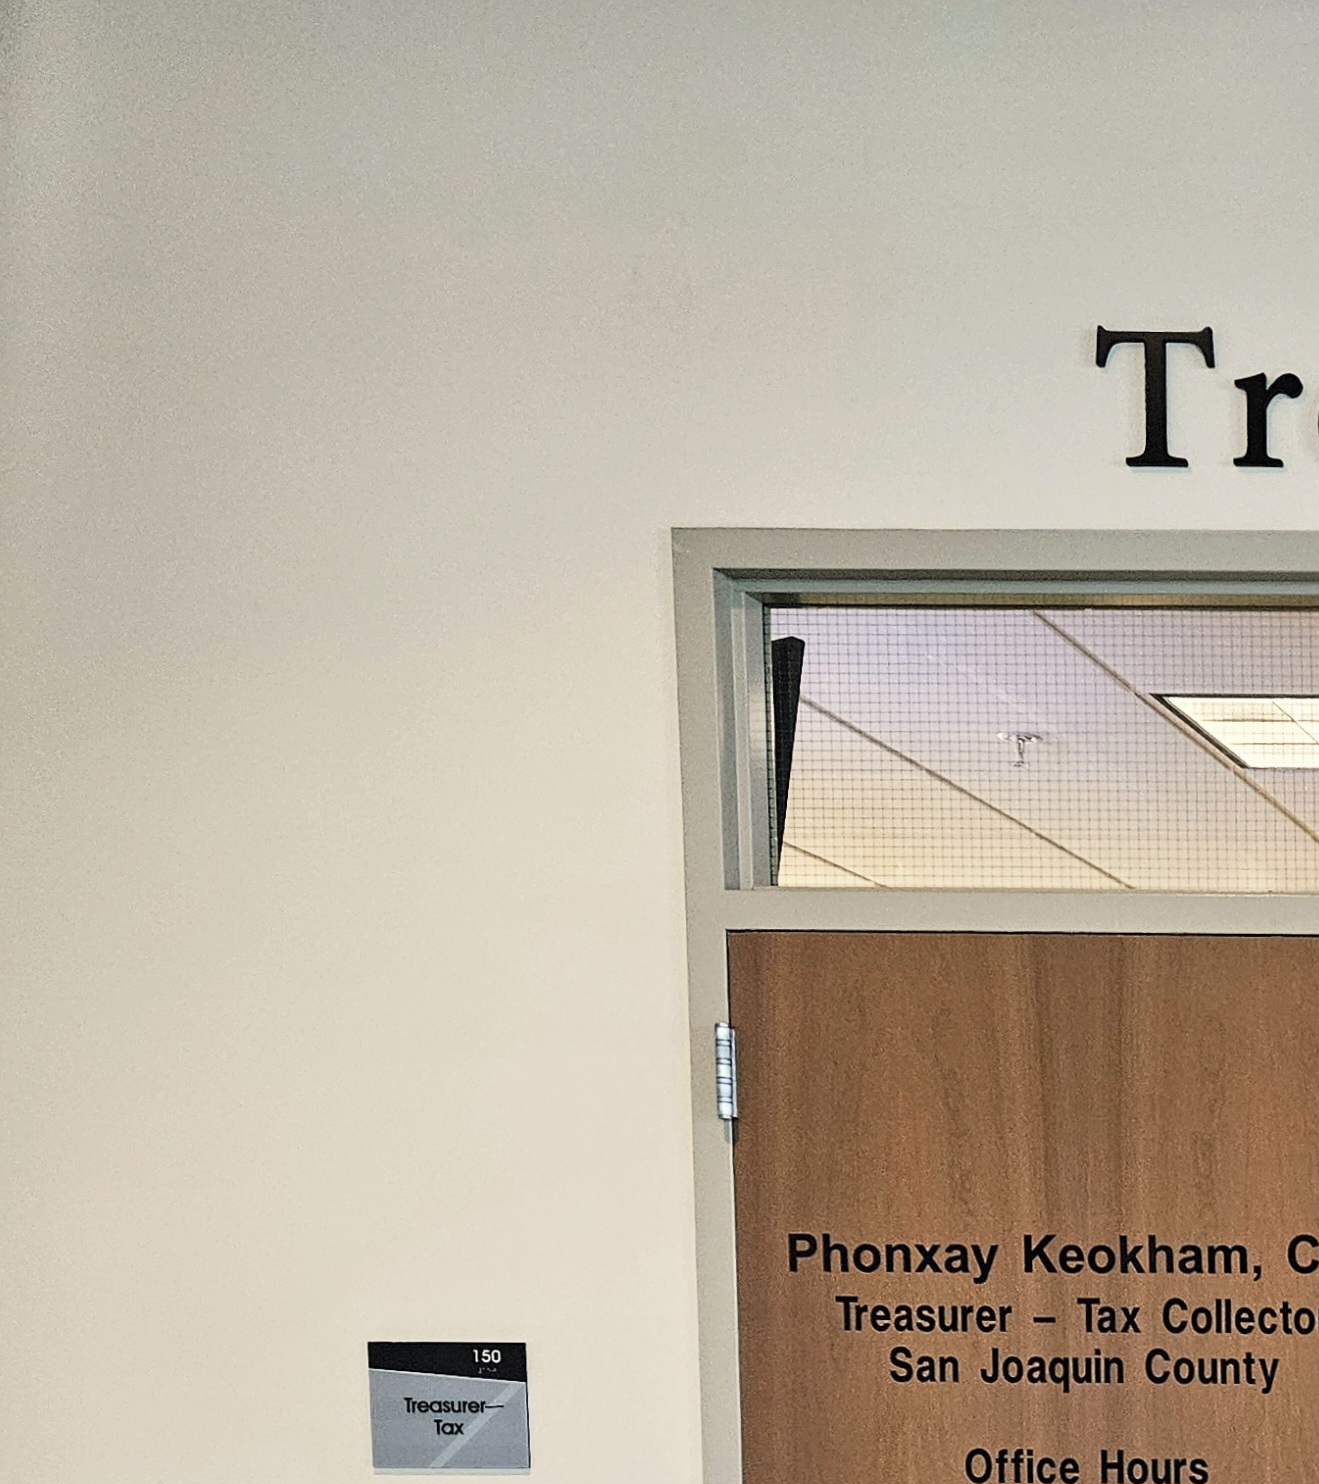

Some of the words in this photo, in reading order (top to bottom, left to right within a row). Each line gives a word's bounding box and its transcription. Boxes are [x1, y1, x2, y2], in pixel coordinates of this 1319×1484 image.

[789, 1233, 998, 1284] Phonxay
[1024, 1234, 1262, 1282] Keokham,
[836, 1296, 1013, 1333] Treasurer
[1077, 1297, 1141, 1334] Tax
[473, 1349, 501, 1363] 150
[889, 1346, 959, 1383] San
[981, 1347, 1124, 1394] Joaquin
[1145, 1348, 1279, 1394] County
[433, 1419, 464, 1436] Tax
[965, 1448, 1080, 1484] Office
